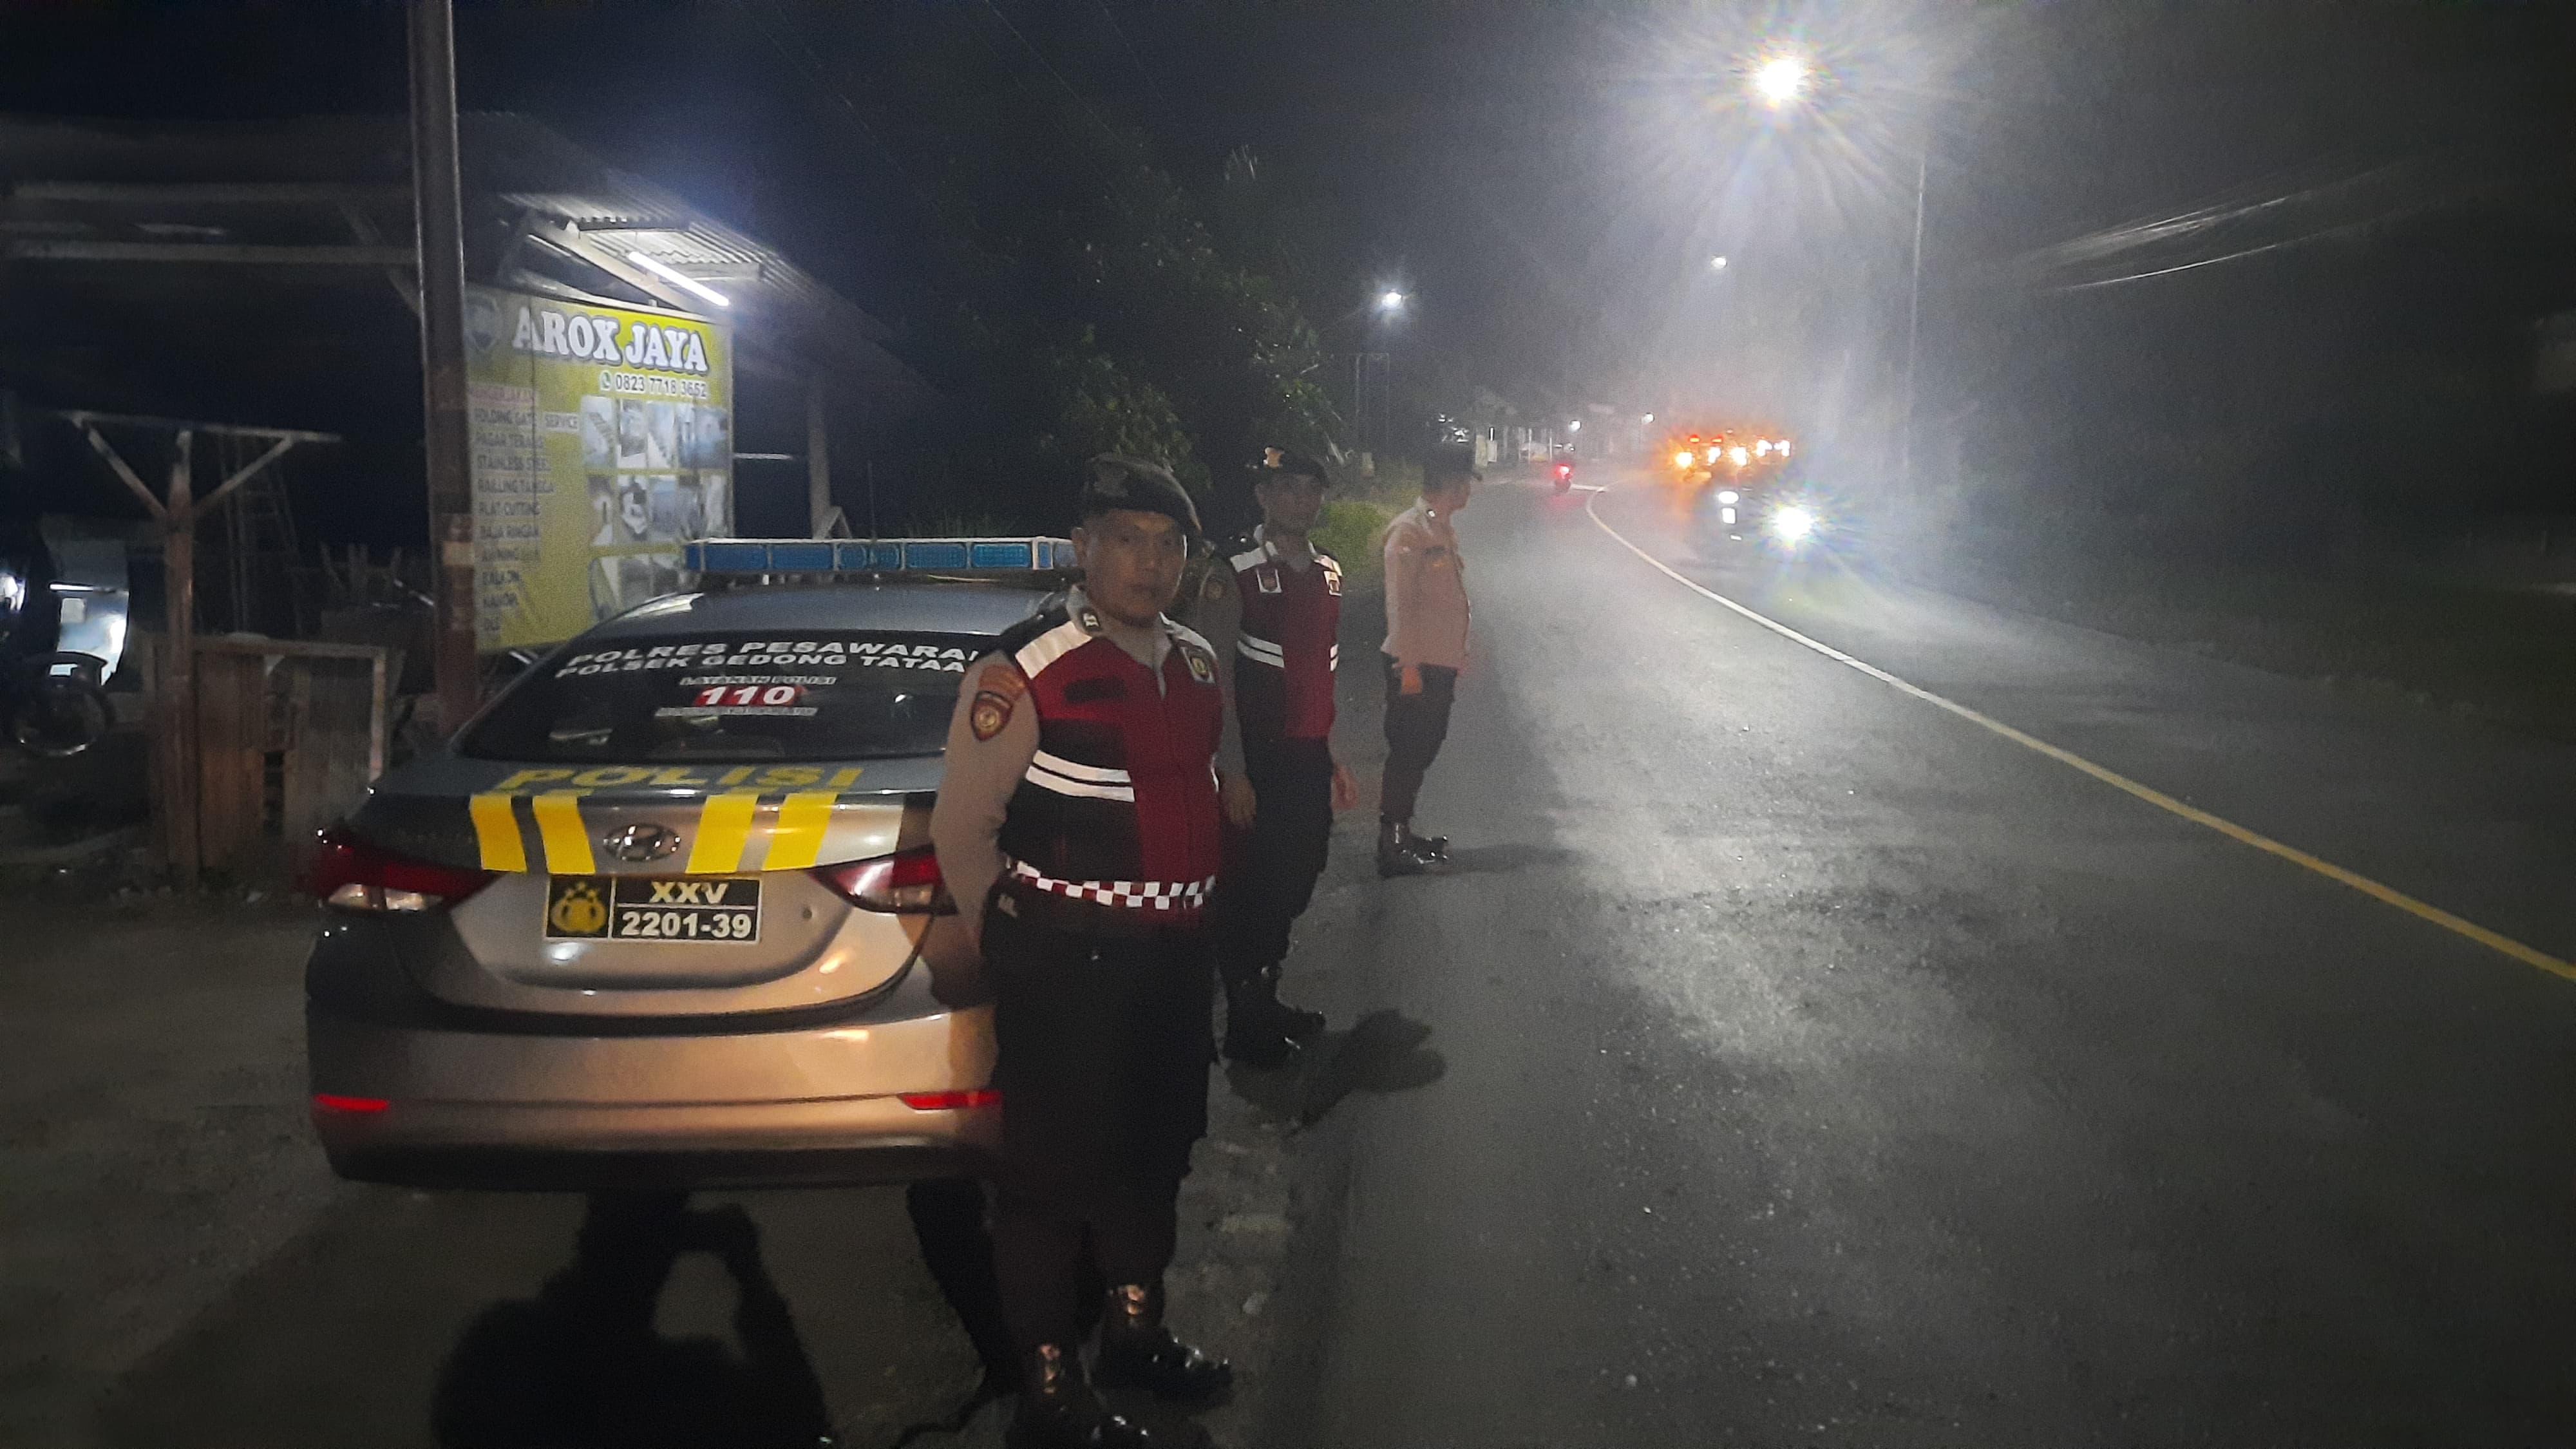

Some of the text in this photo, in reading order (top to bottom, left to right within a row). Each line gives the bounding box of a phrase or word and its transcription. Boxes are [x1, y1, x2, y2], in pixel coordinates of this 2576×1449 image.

[513, 307, 709, 374] AROX JAYA
[615, 374, 645, 392] 0823
[649, 377, 676, 395] 7718
[545, 413, 578, 430] SERVICE
[477, 454, 524, 471] STAINLESS
[555, 657, 691, 678] POLSEK
[702, 654, 847, 666] GEDONG
[567, 643, 727, 667] POLRES
[702, 685, 796, 705] 110
[497, 766, 864, 789] POLISI
[649, 880, 729, 904] XXV
[621, 911, 752, 938] 2201-39
